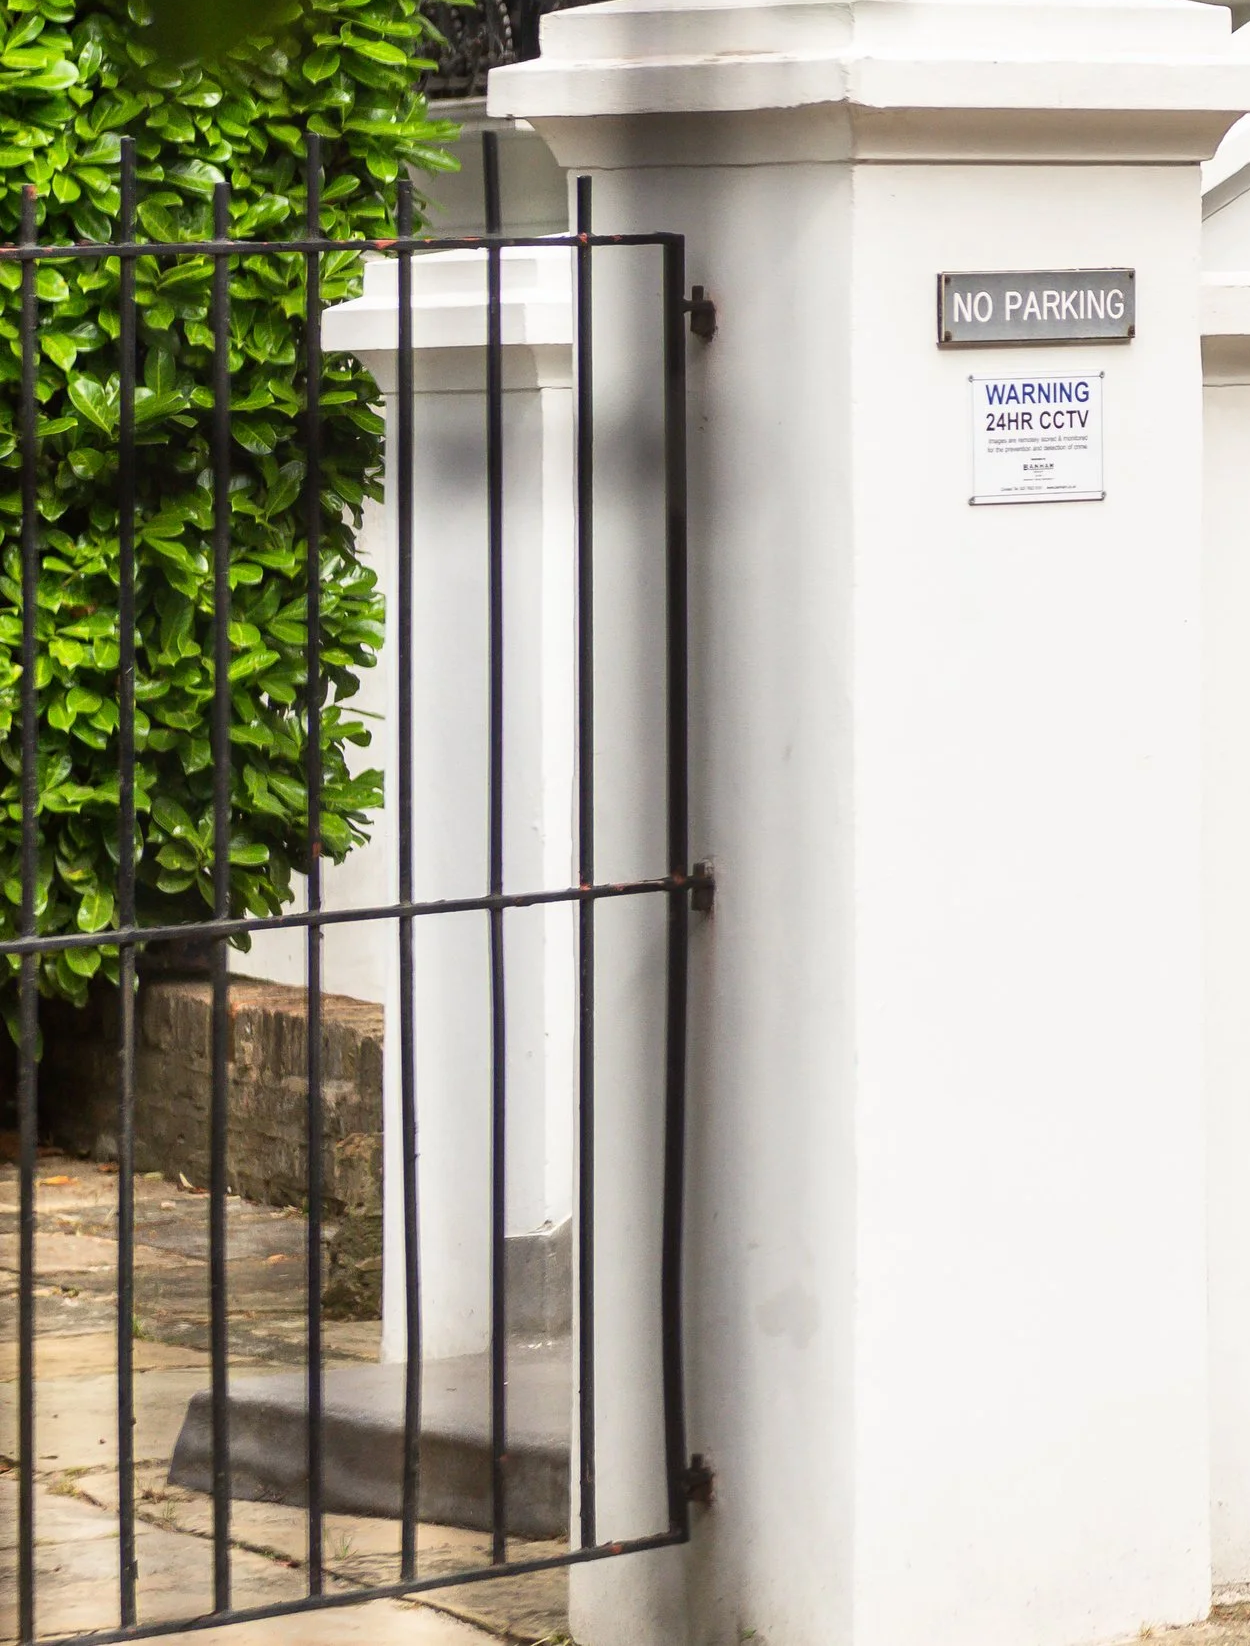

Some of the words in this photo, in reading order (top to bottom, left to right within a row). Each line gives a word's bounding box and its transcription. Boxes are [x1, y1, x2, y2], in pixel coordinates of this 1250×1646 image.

[953, 291, 993, 323] NO
[1005, 288, 1125, 322] PARKING
[985, 381, 1090, 405] WARNING
[985, 411, 1034, 432] 24HR
[1038, 409, 1090, 430] CCTV
